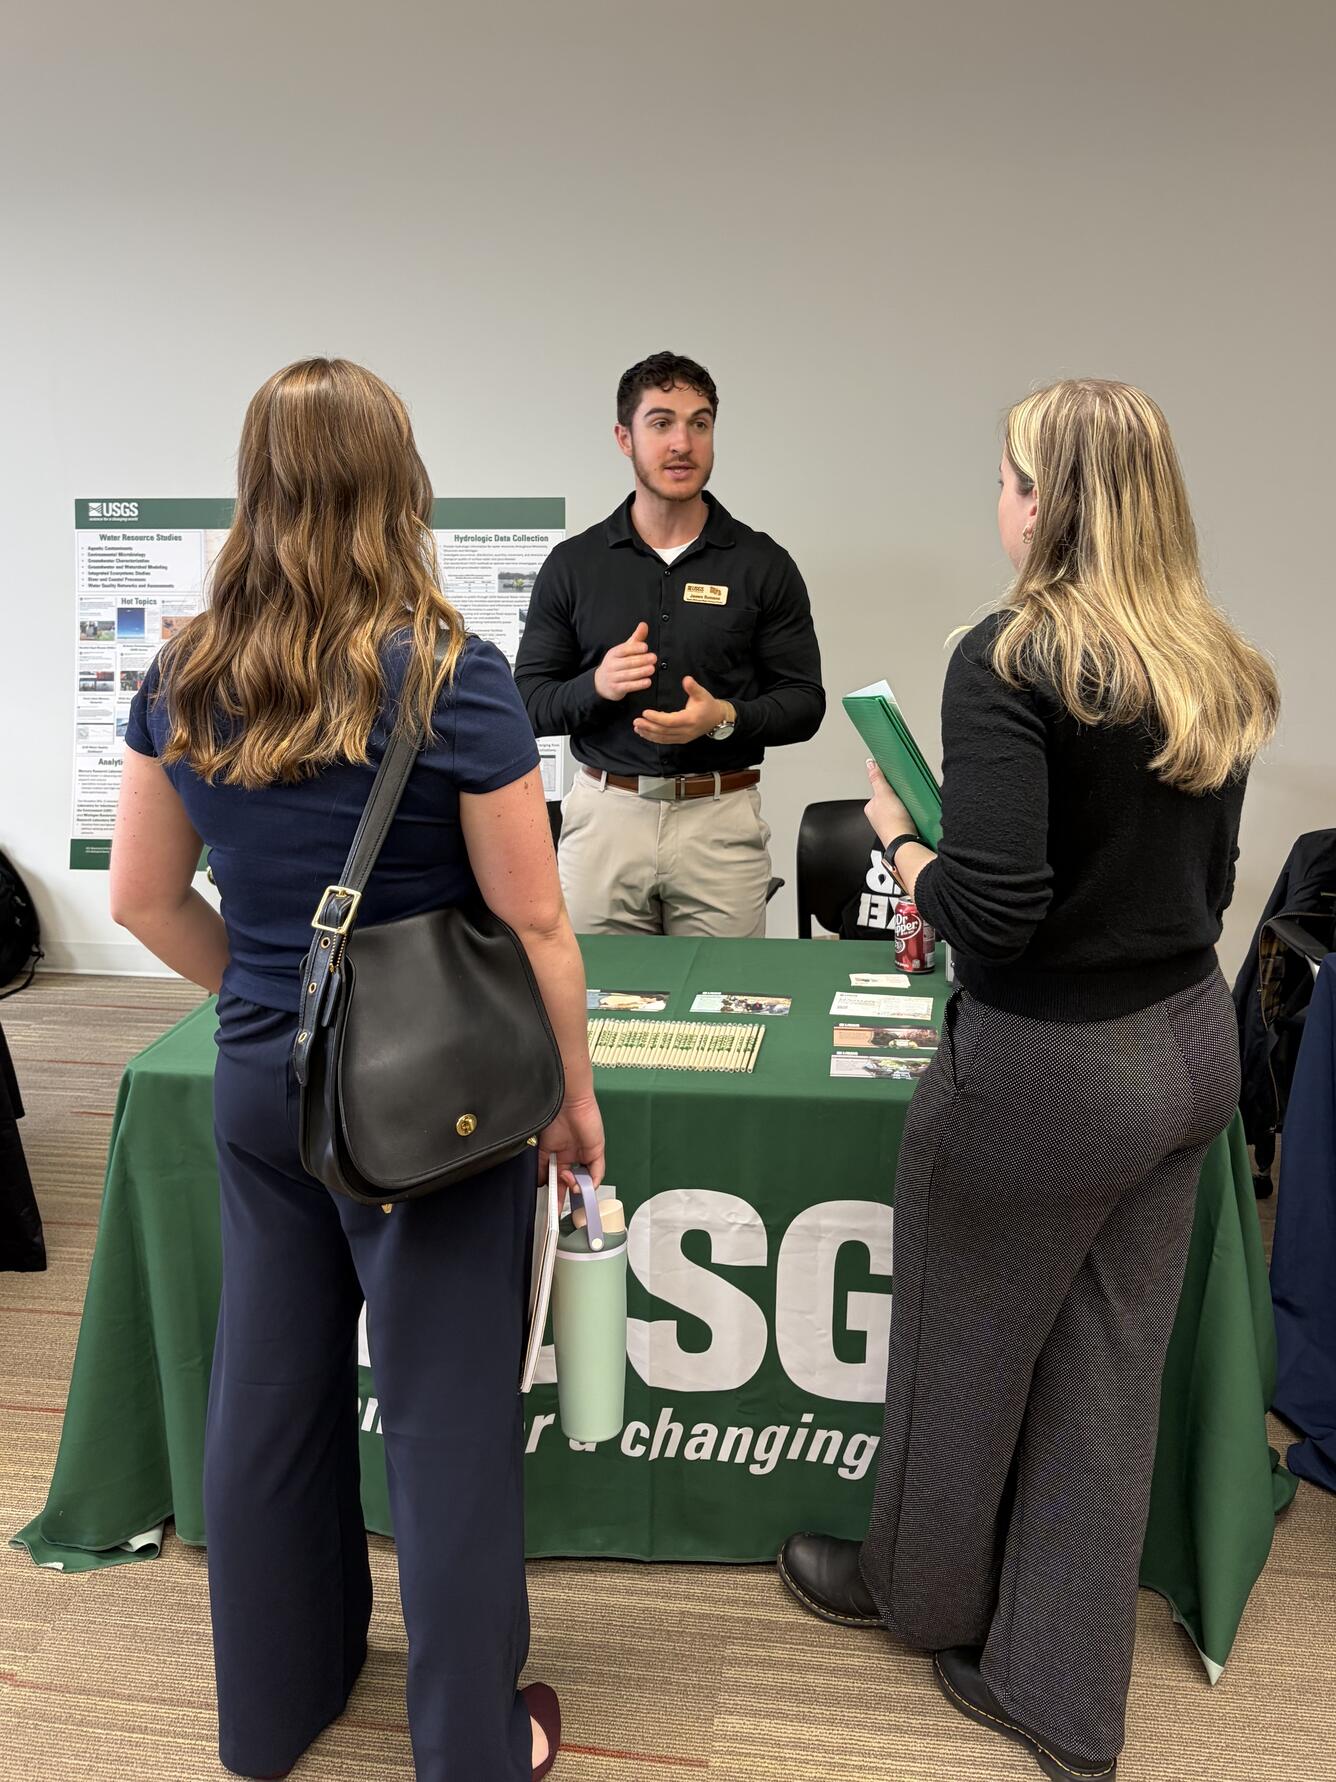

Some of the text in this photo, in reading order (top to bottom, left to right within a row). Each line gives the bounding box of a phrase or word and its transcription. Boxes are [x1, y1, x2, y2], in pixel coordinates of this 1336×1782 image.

[103, 502, 139, 517] USGS
[99, 533, 121, 541] Water
[156, 533, 182, 541] Studies
[454, 534, 549, 543] Hydrologic Data Collection
[121, 597, 134, 605] Hot
[134, 597, 157, 606] Topics
[896, 913, 909, 925] Dr
[895, 919, 919, 937] pper
[621, 1407, 880, 1481] changing
